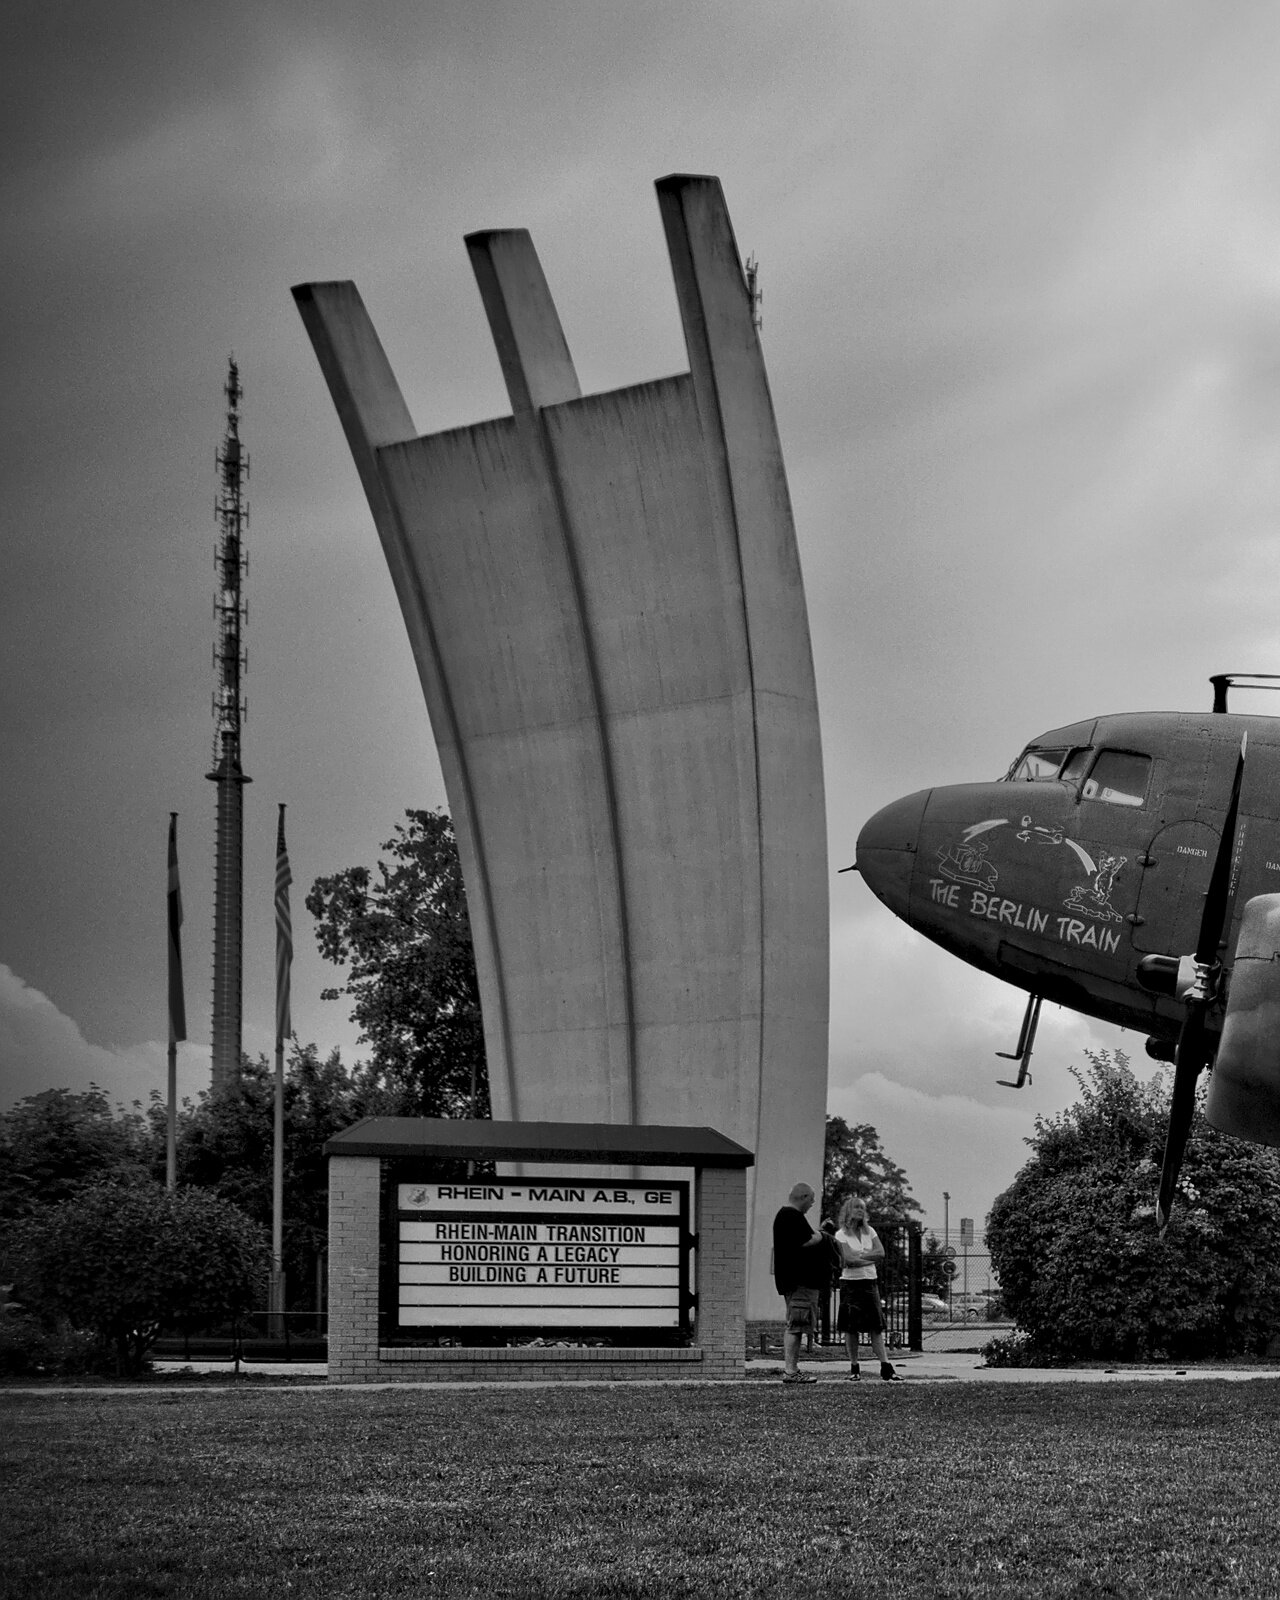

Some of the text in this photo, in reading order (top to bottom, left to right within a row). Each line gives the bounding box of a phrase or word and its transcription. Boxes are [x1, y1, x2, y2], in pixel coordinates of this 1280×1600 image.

[1177, 845, 1208, 858] DANGER
[1228, 823, 1247, 897] PROPELLER
[929, 879, 1121, 954] THE BERLIN TRAIN
[437, 1186, 504, 1200] RHEIN
[529, 1188, 585, 1203] MAIN
[644, 1192, 673, 1204] GE
[436, 1224, 646, 1243] RHEIN-MAIN TRANSITION
[441, 1245, 620, 1263] HONORING A LEGACY
[449, 1266, 620, 1284] BUILDING A FUTURE
